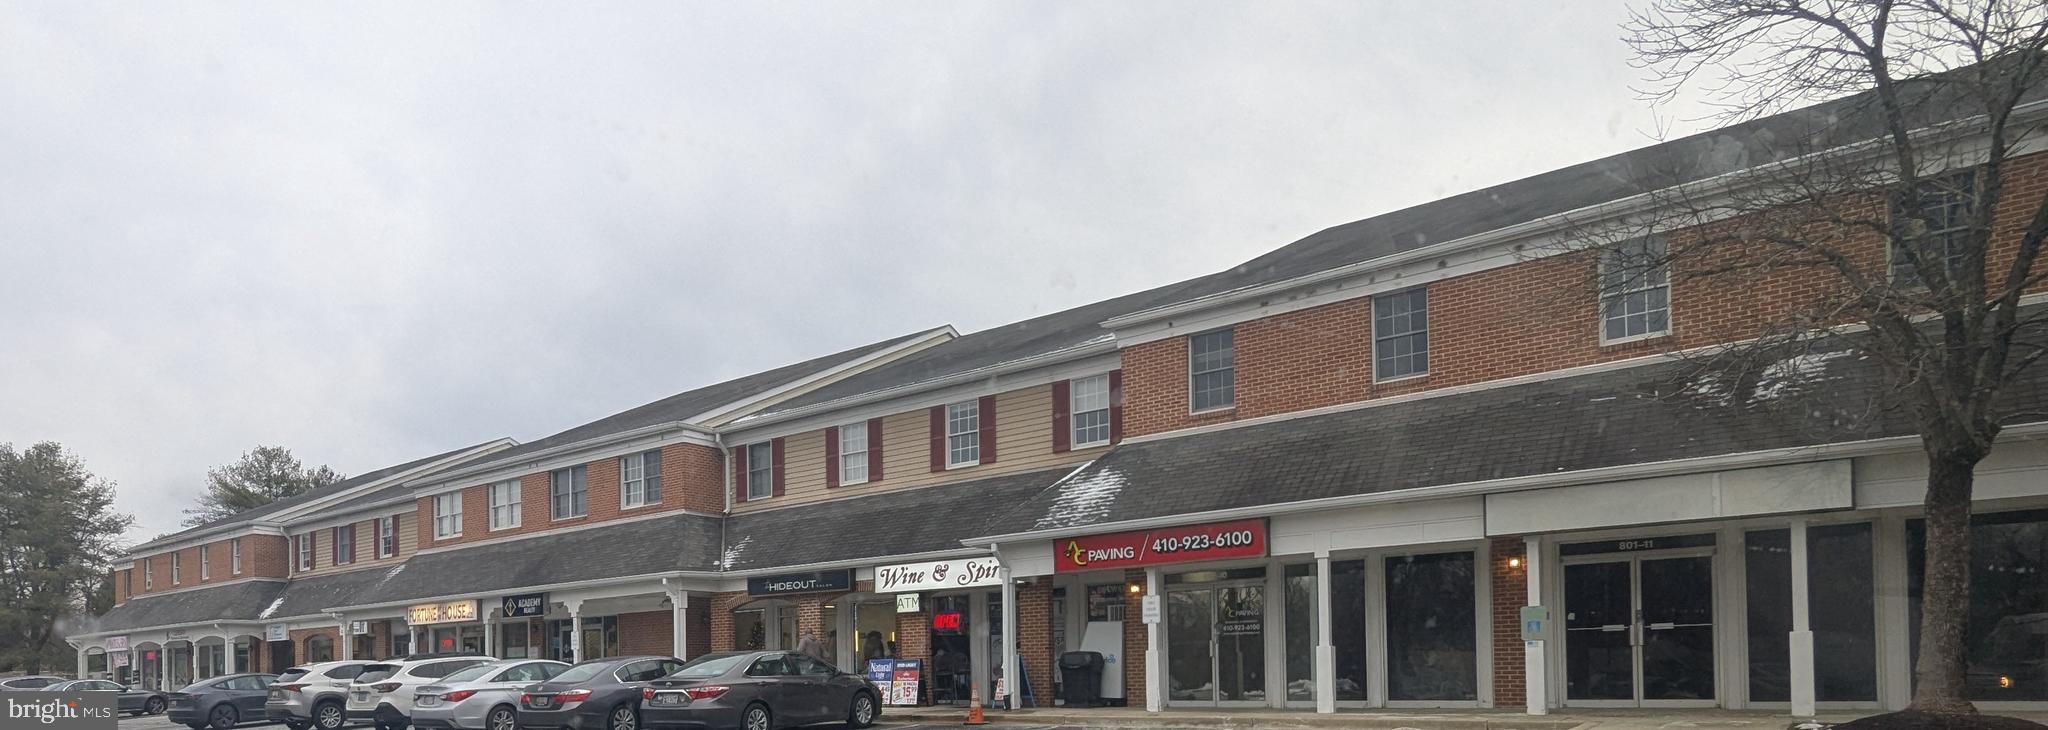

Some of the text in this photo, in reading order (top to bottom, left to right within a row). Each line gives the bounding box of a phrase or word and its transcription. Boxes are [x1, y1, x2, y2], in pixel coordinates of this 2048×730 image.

[1088, 546, 1135, 562] PAVING
[1152, 530, 1252, 552] 410-923-6100
[880, 559, 1000, 589] Wine & Spir
[769, 580, 817, 591] HIDEOUT
[518, 597, 541, 607] ACADEMY
[897, 596, 920, 609] ATM
[408, 606, 437, 622] FORTUNE
[442, 603, 466, 620] HOUSE
[870, 662, 892, 672] Natural
